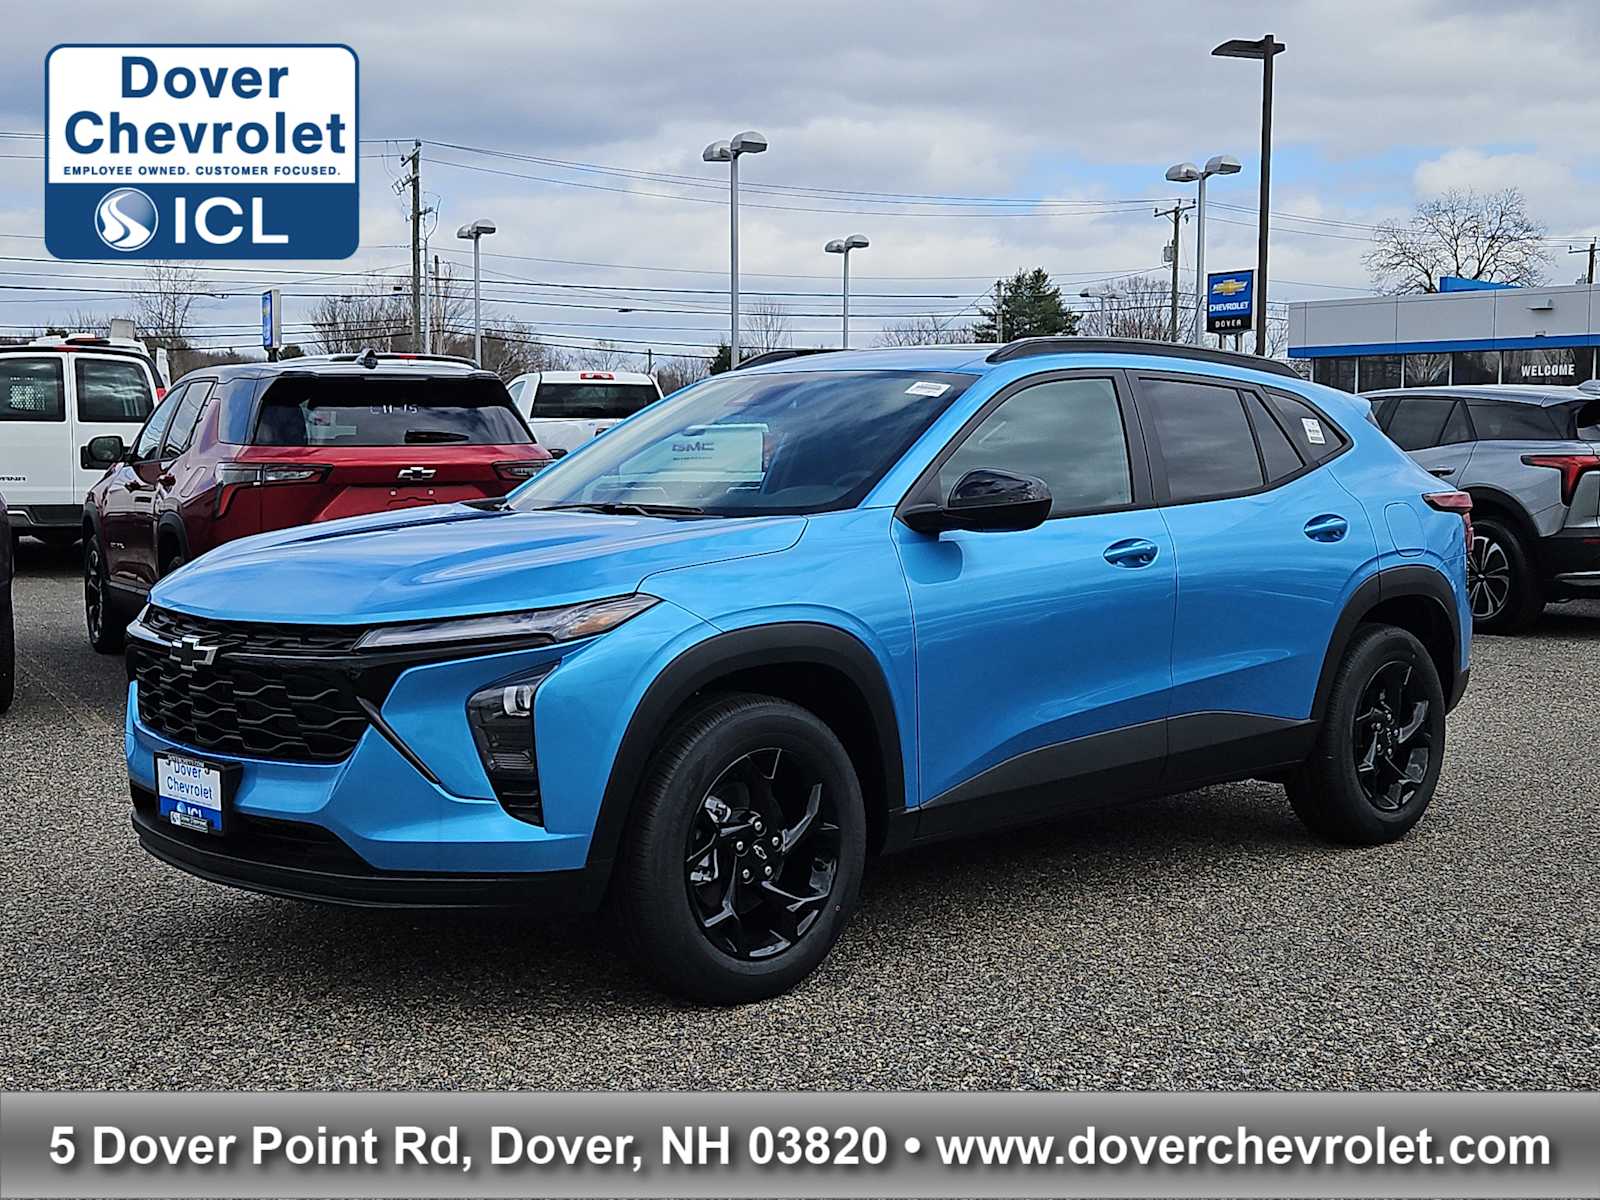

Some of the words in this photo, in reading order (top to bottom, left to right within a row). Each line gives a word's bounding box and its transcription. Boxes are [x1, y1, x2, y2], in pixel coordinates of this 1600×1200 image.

[1209, 301, 1249, 312] CHEVROLET
[1215, 319, 1242, 328] DOVER
[1521, 363, 1575, 377] WELCOME
[672, 441, 714, 452] GMC
[174, 762, 202, 779] Dover
[167, 776, 213, 800] Chevrolet
